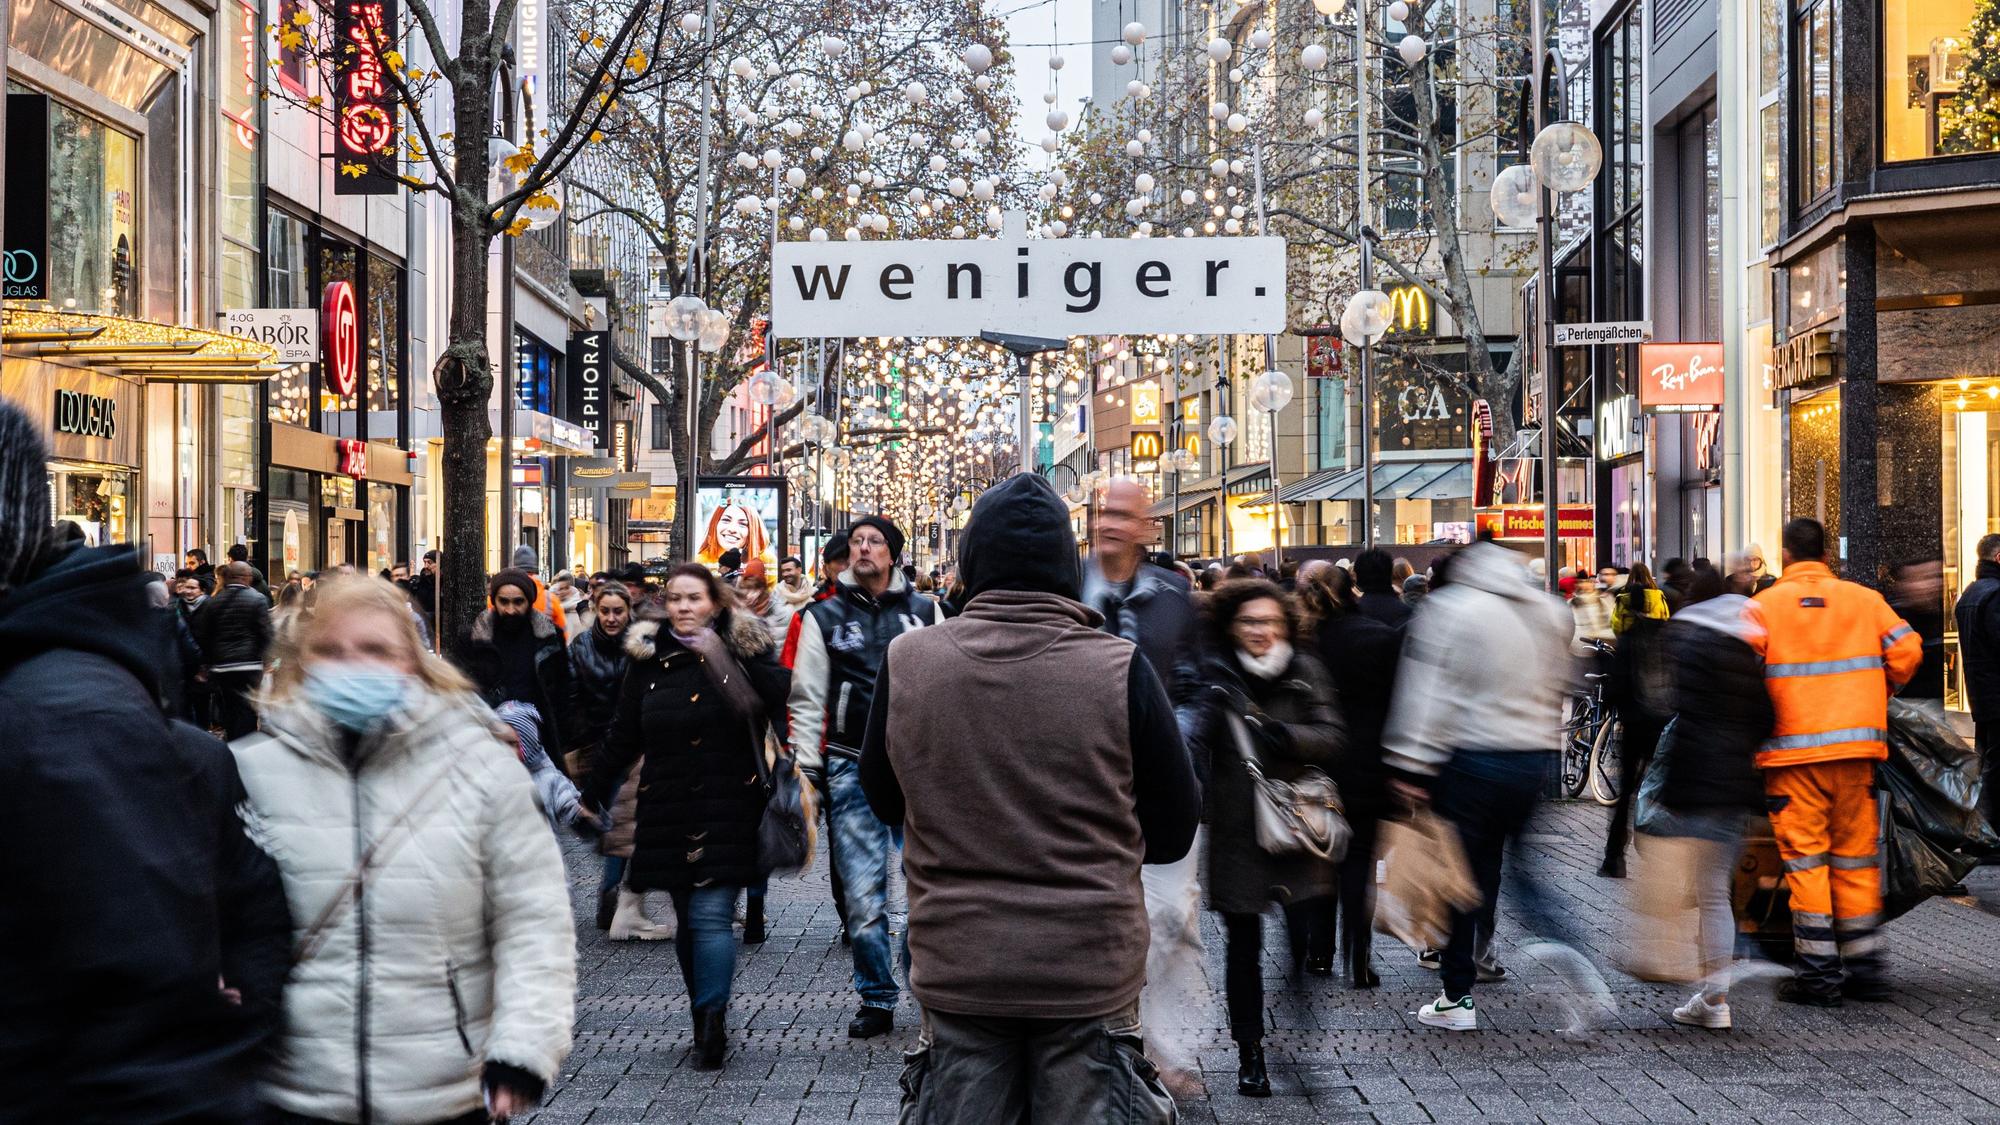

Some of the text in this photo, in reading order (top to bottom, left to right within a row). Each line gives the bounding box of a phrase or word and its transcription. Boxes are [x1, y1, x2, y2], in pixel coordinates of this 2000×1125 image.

[792, 247, 1267, 313] weniger.
[230, 313, 254, 323] 4.OG
[1568, 326, 1642, 342] Perlengäßchen
[286, 350, 311, 358] SPA
[1651, 355, 1716, 391] Ray-Ban
[60, 388, 117, 440] DOUGLAS
[1601, 395, 1630, 460] ONLY
[1508, 515, 1545, 530] Frische
